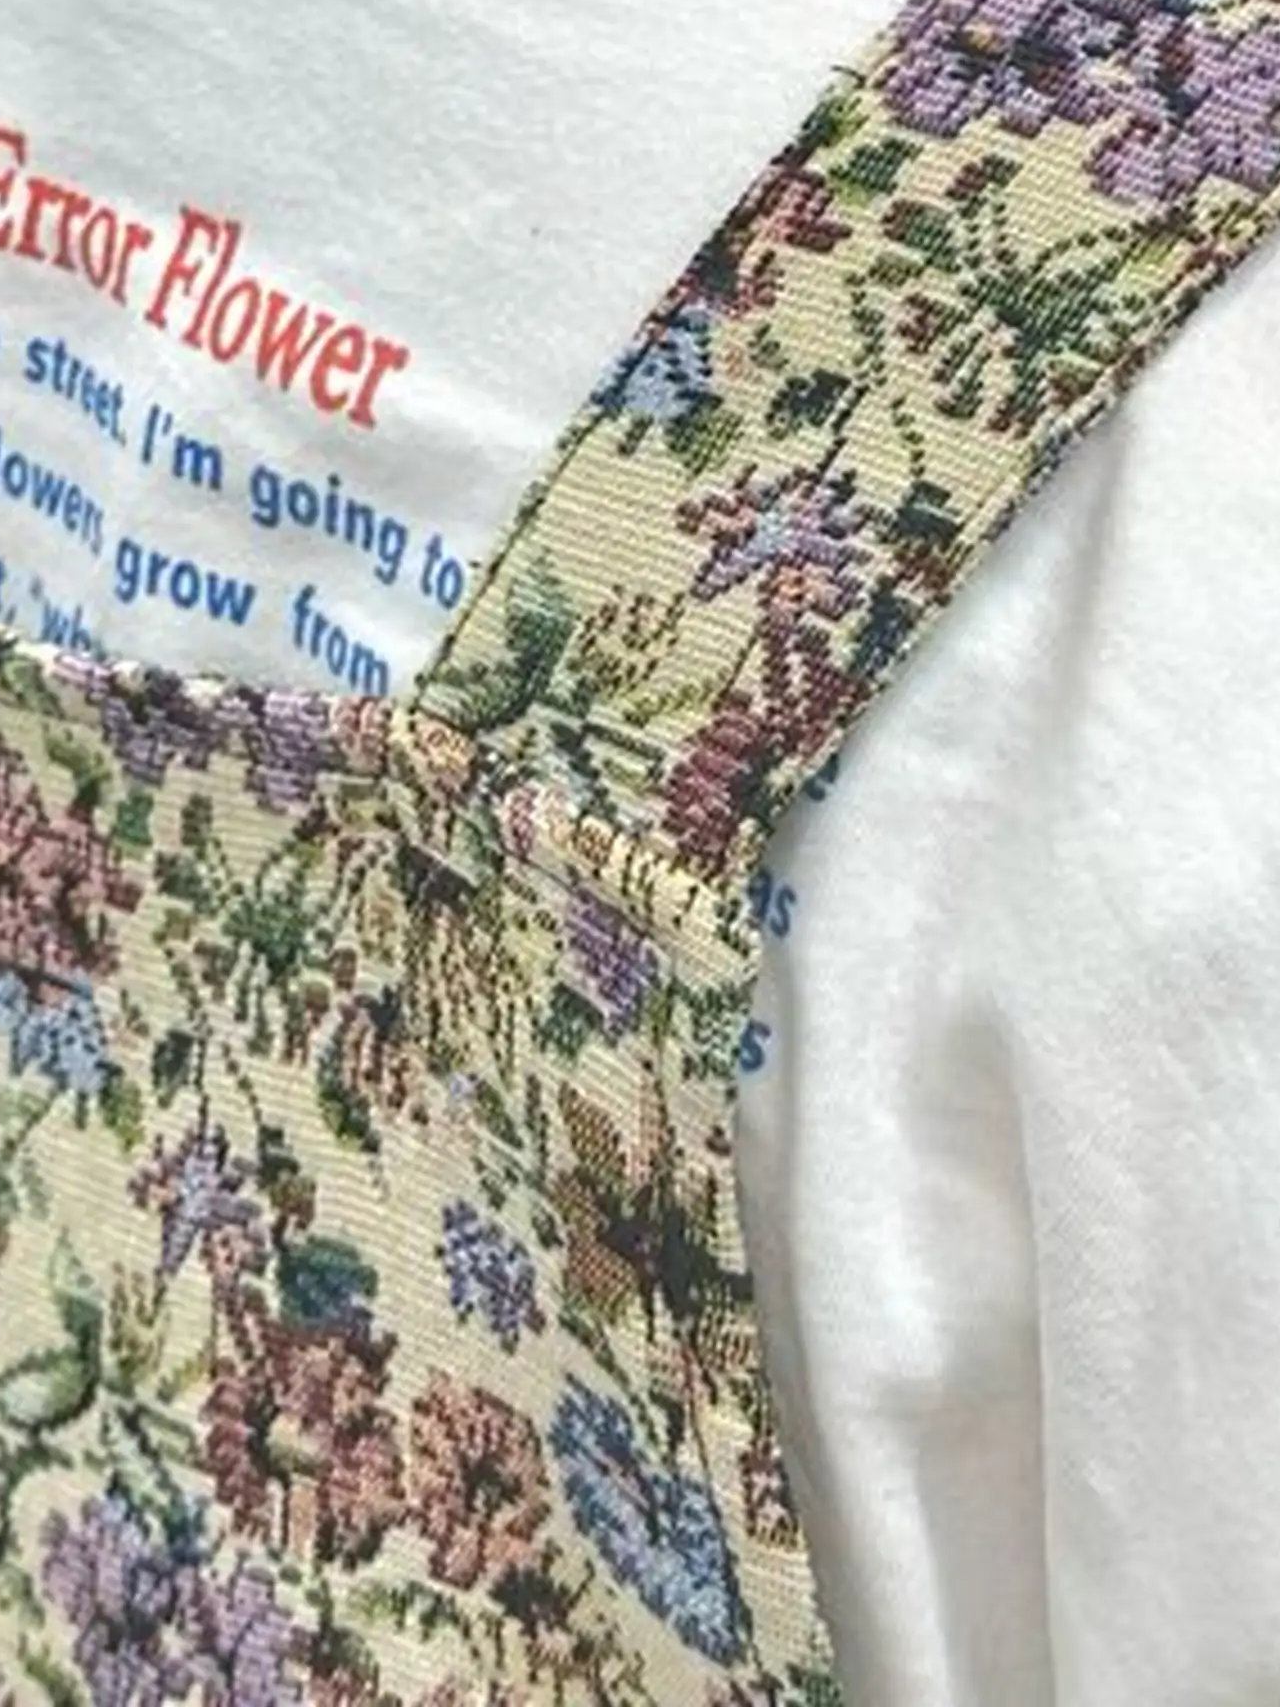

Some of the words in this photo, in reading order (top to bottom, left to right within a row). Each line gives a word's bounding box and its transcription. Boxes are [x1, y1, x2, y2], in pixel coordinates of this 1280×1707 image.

[144, 203, 411, 431] Flower
[141, 402, 223, 492] I'm
[249, 472, 409, 587] going
[420, 534, 465, 611] to
[114, 537, 257, 628] grow
[291, 584, 391, 698] from
